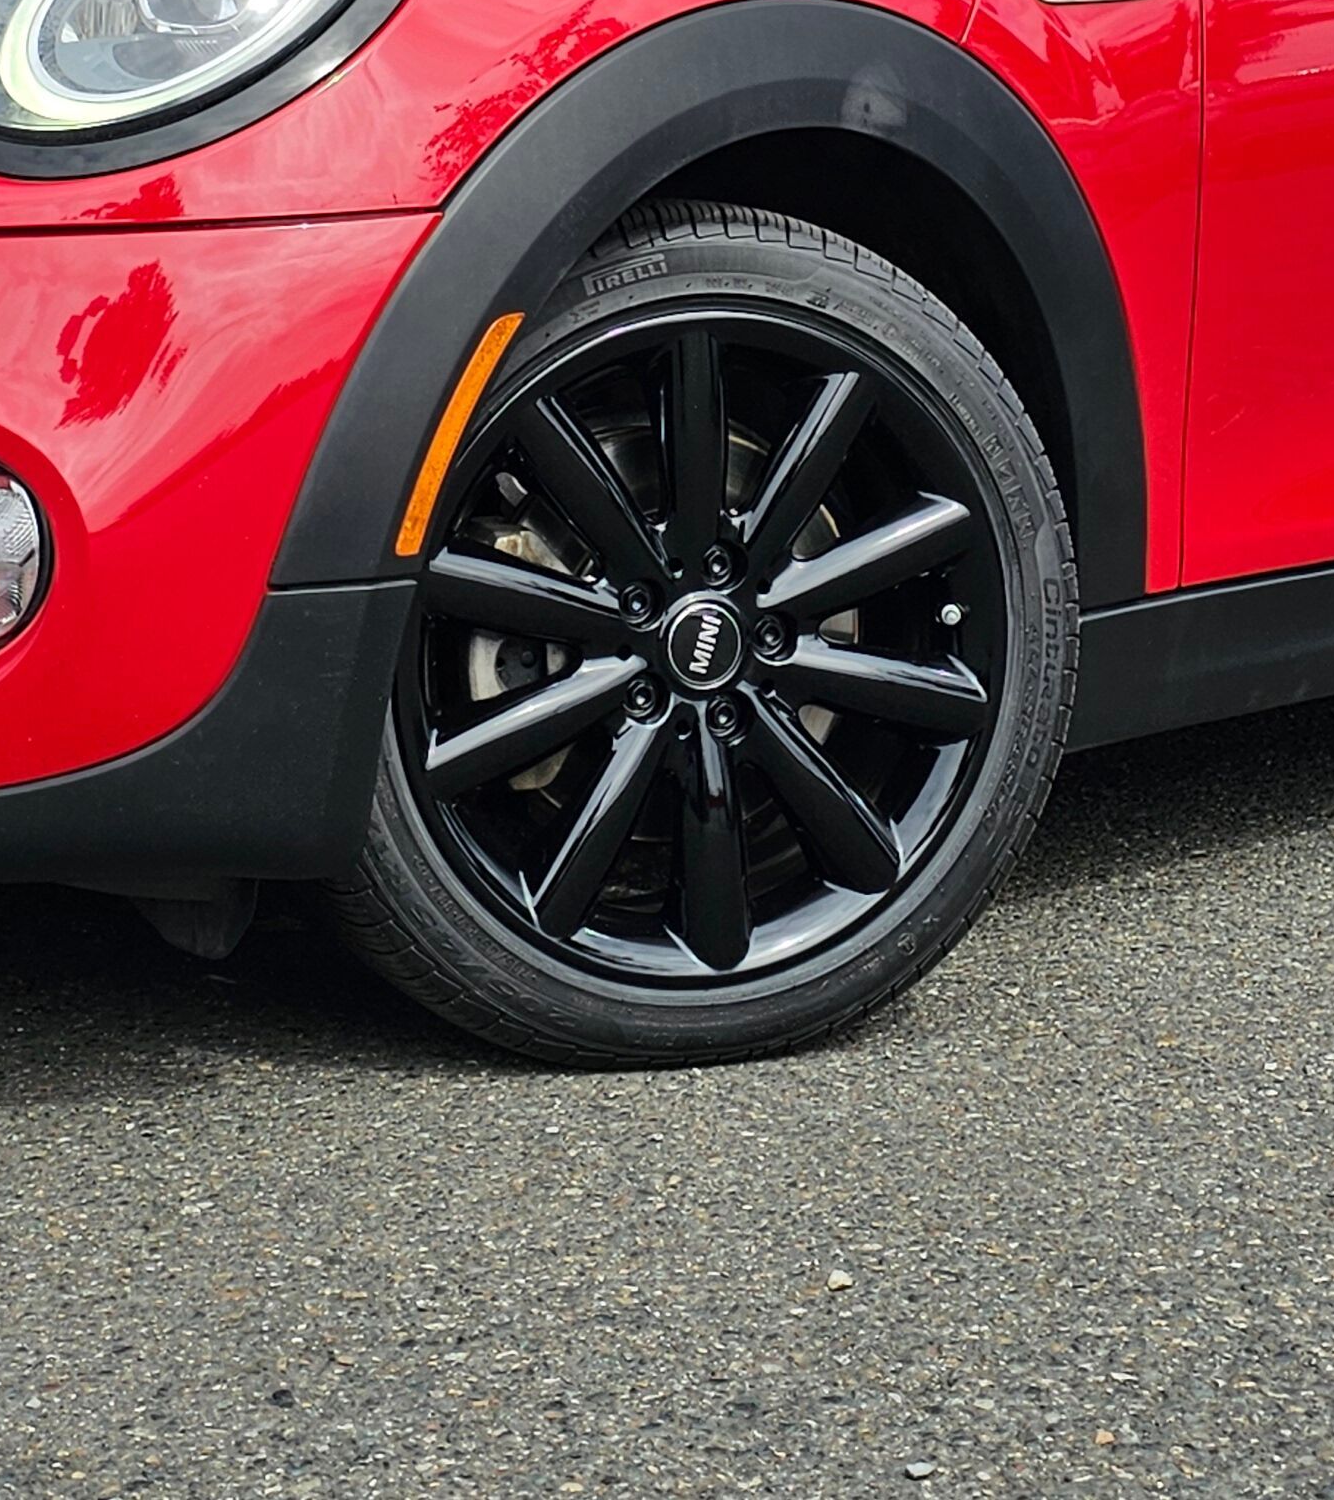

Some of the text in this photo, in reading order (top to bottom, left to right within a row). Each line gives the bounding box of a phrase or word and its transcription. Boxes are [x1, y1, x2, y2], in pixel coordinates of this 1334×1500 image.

[582, 252, 667, 297] PIRELLI
[688, 614, 723, 675] MINI
[1026, 577, 1062, 767] Cinturato
